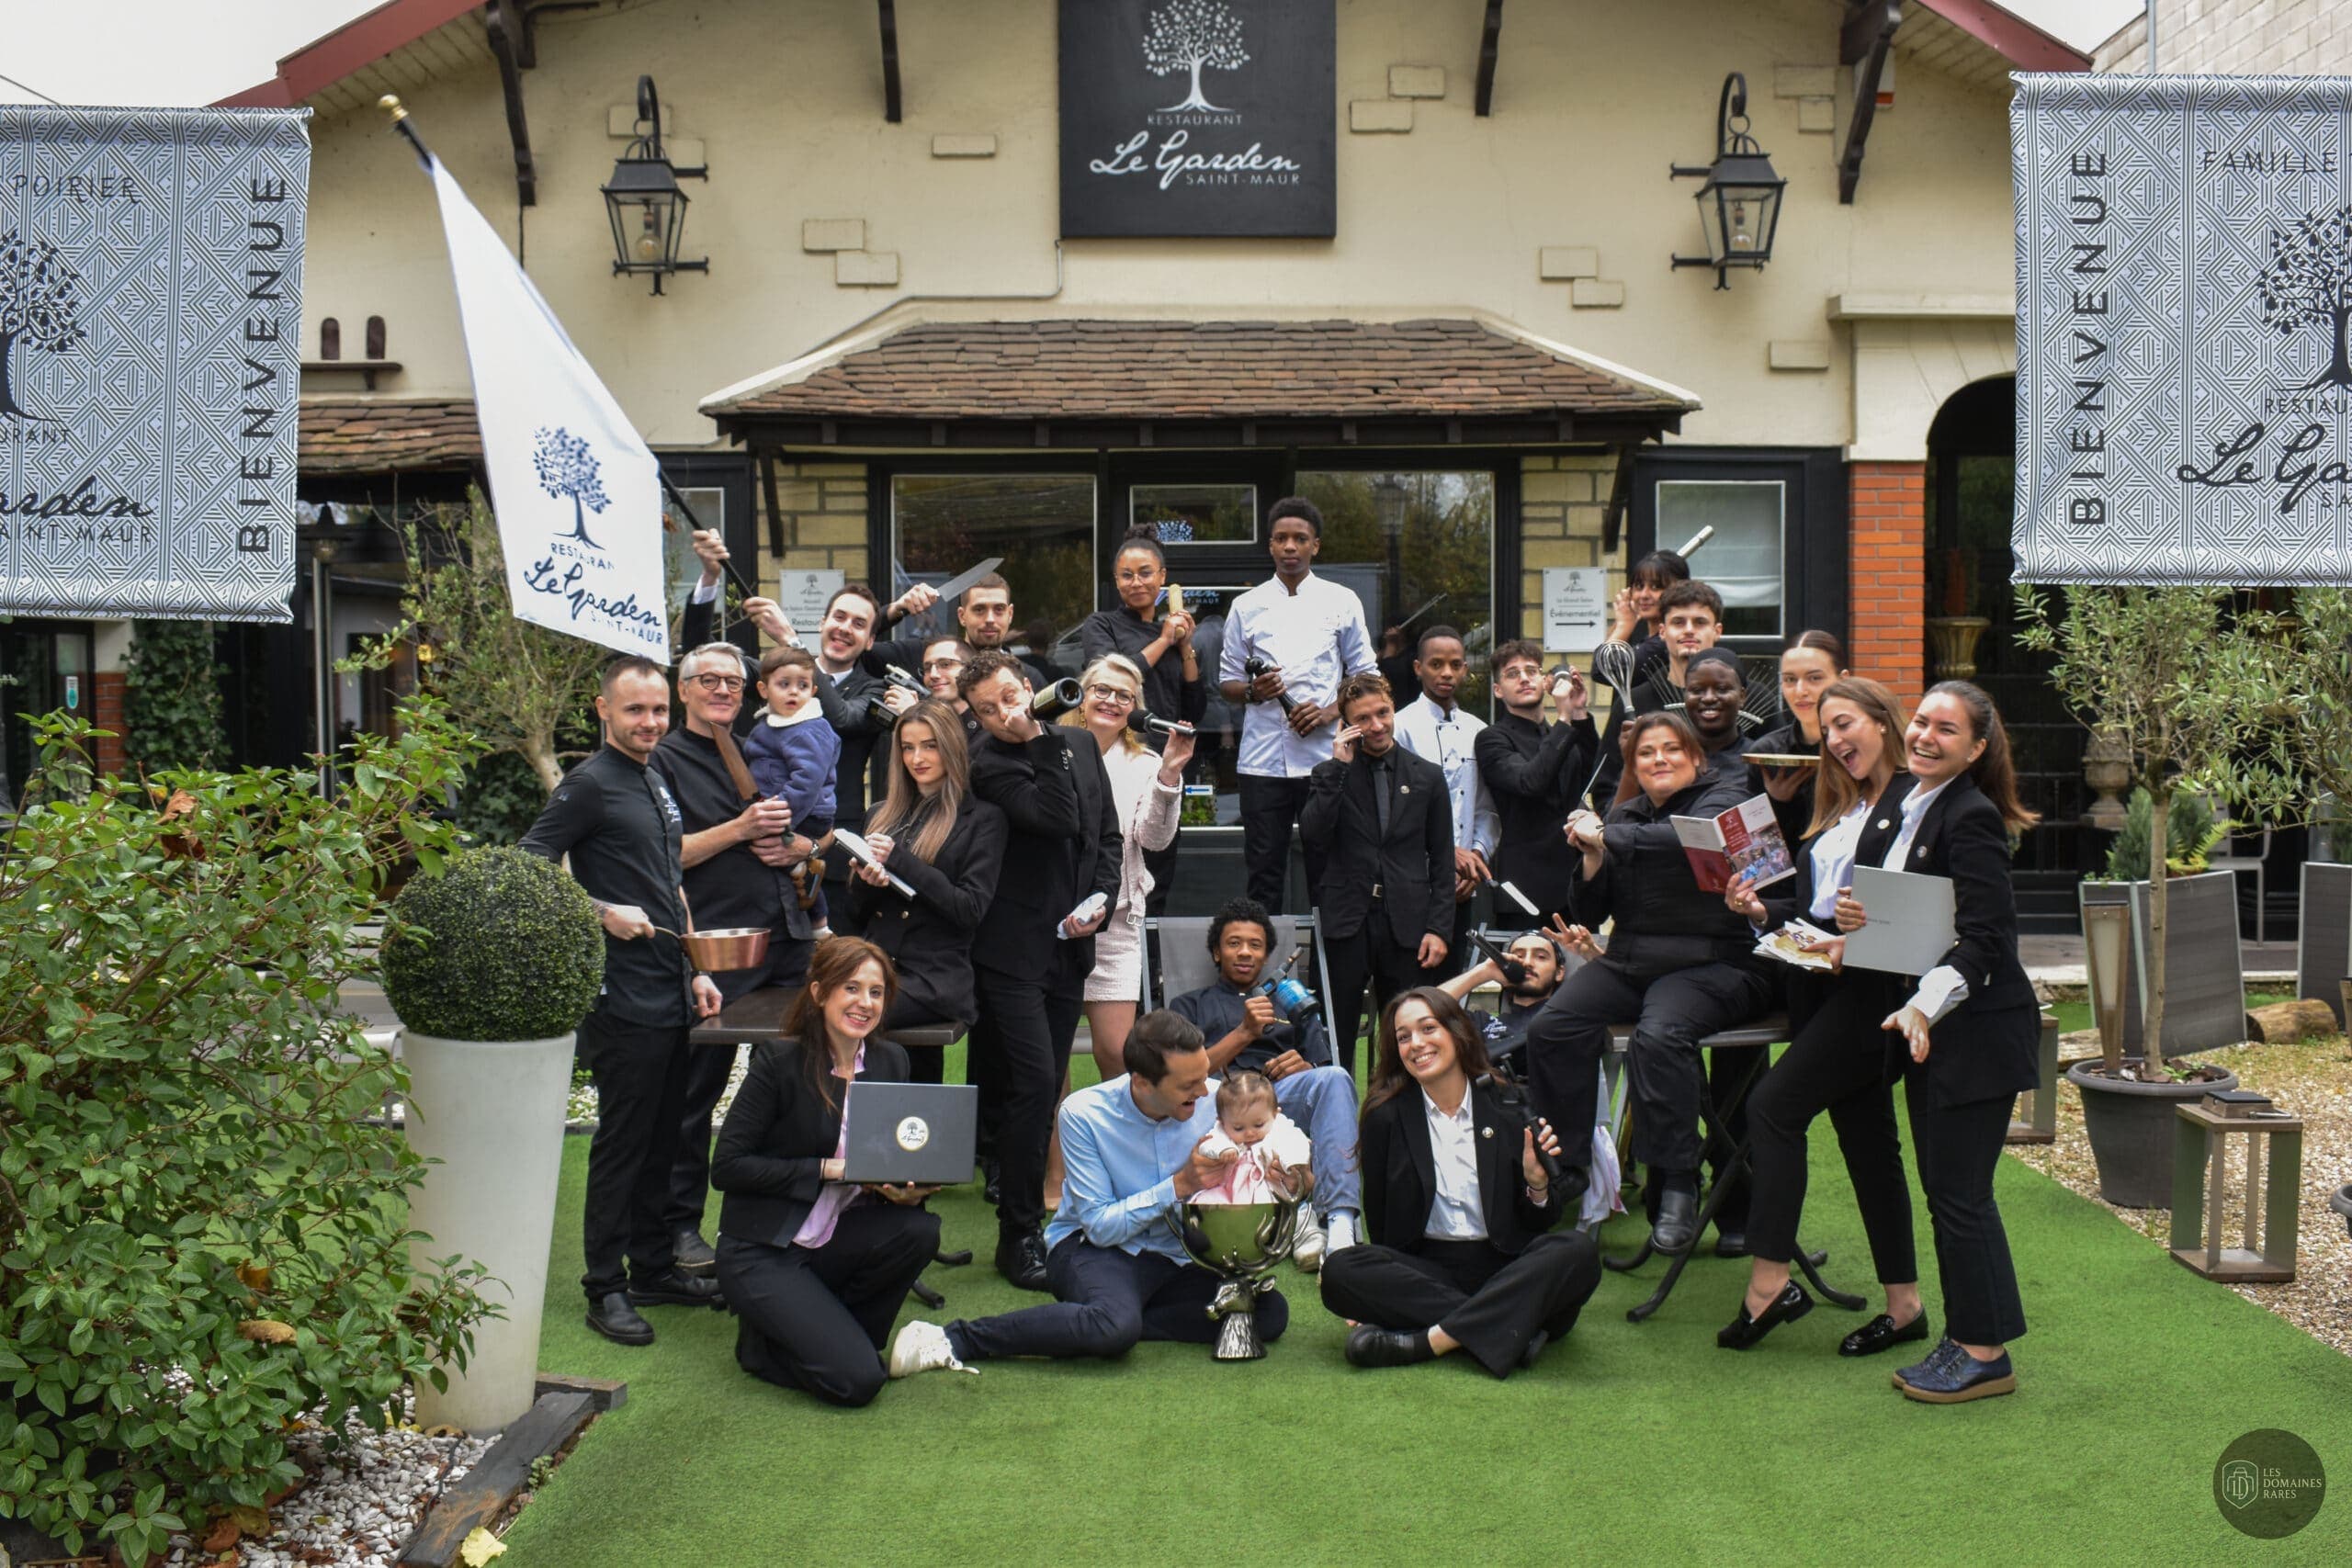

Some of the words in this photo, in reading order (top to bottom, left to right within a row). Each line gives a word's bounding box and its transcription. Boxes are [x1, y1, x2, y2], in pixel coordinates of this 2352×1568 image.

[1148, 114, 1242, 126] RESTAURANT
[11, 175, 142, 204] POIRIER
[1090, 130, 1149, 175] Le
[1155, 130, 1301, 190] Garden
[1185, 173, 1300, 185] SAINT-MAUR
[2203, 151, 2338, 175] FAMILLE
[238, 178, 286, 553] BIENVENUE
[2070, 152, 2109, 526] BIENVENUE
[2177, 423, 2266, 488] Le
[524, 556, 563, 594] Le
[563, 562, 662, 626] Garden
